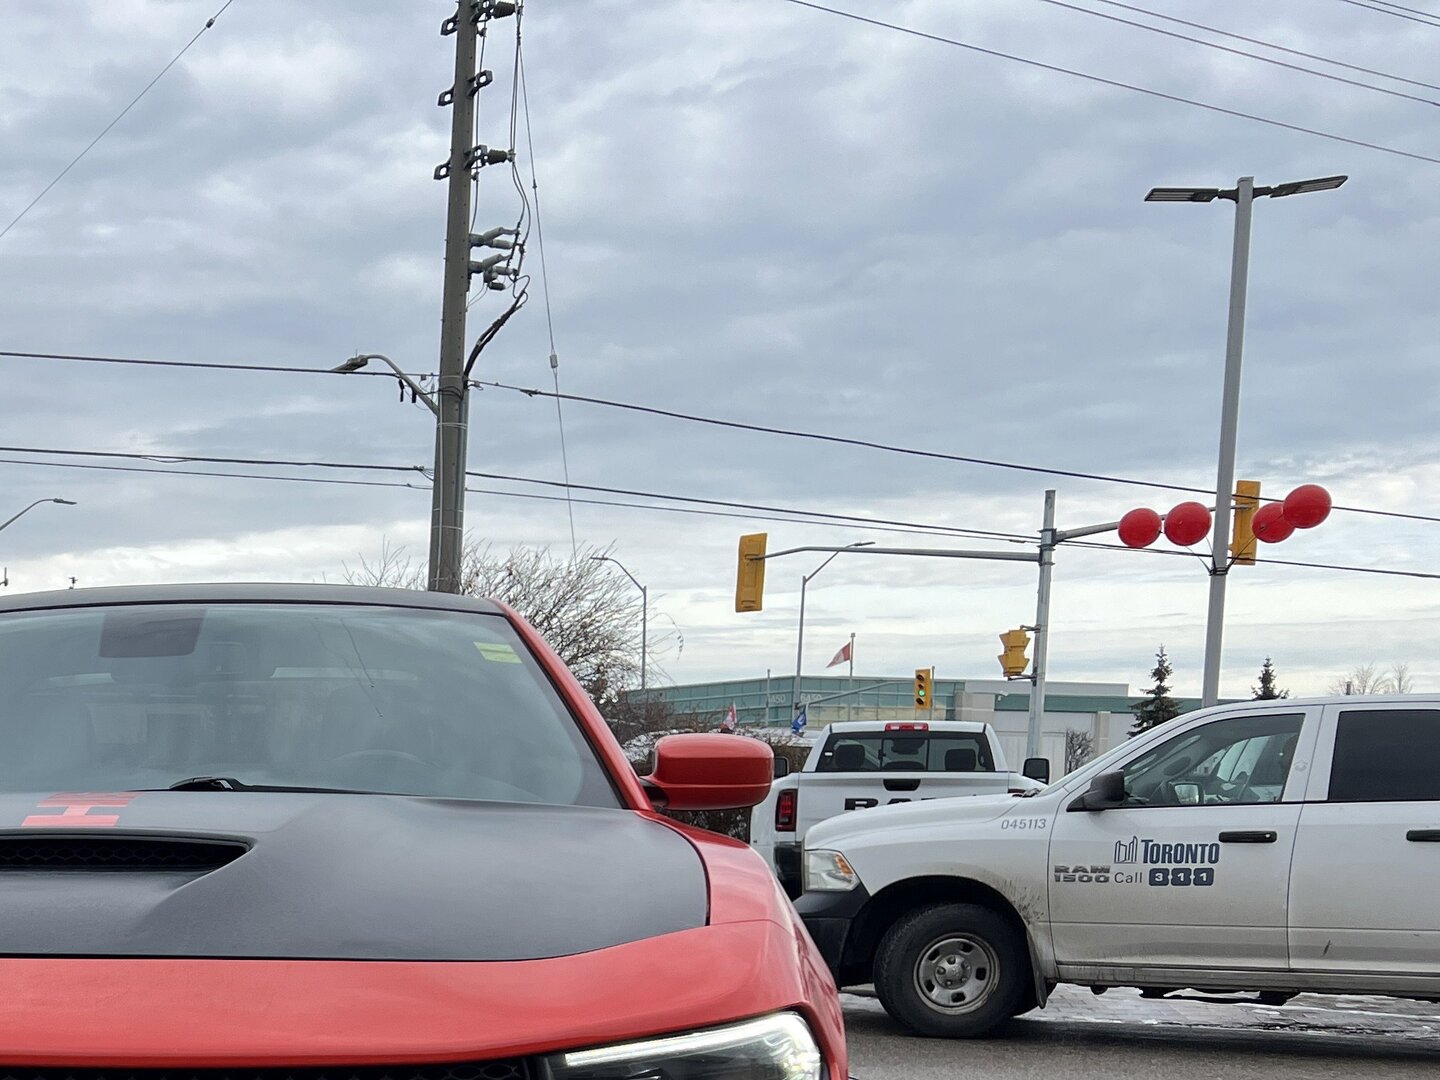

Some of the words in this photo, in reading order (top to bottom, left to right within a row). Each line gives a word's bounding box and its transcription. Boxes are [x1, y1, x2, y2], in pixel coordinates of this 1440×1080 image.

[1001, 818, 1047, 830] 045113
[1141, 839, 1220, 864] TORONTO
[1054, 865, 1110, 874] RAM
[1054, 874, 1110, 883] 1500
[1114, 871, 1143, 884] Call
